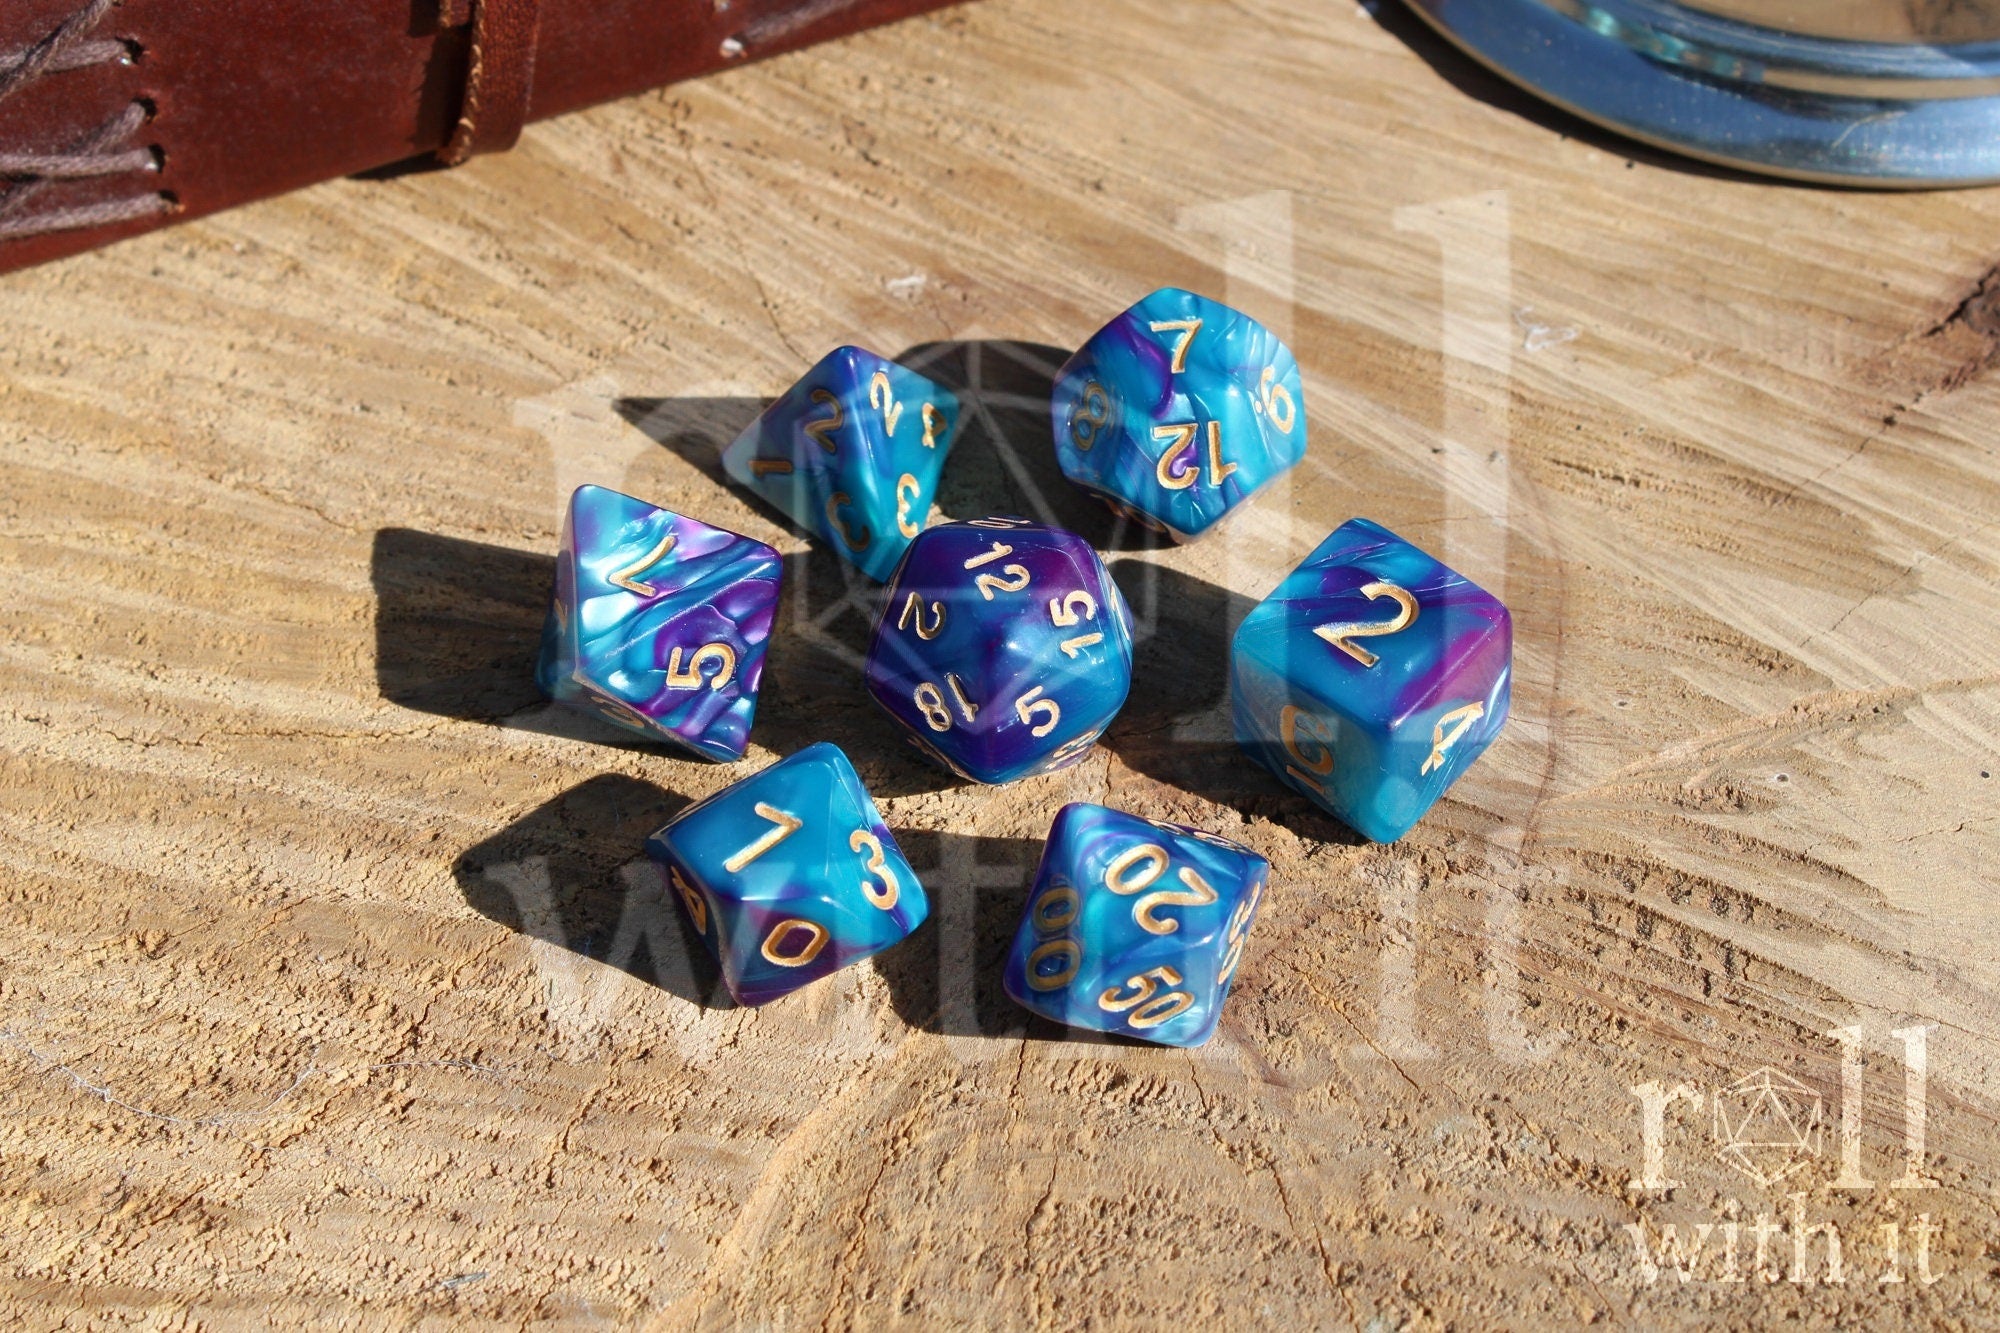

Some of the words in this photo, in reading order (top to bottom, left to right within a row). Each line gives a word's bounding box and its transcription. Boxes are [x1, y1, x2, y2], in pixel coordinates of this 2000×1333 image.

[1151, 320, 1202, 373] 7
[805, 388, 844, 453] 2
[870, 372, 904, 438] 2
[921, 401, 949, 449] 4
[1070, 380, 1111, 451] 8
[748, 459, 793, 479] 1
[1153, 421, 1238, 490] 12
[826, 491, 870, 552] 3
[896, 472, 920, 539] 3
[609, 535, 679, 597] 7
[963, 541, 1031, 601] 12
[898, 591, 947, 641] 2
[1050, 589, 1105, 660] 15
[1311, 582, 1418, 668] 2
[665, 642, 736, 690] 5
[912, 671, 980, 732] 18
[1015, 685, 1061, 738] 5
[1421, 700, 1485, 777] 4
[723, 801, 803, 873] 7
[849, 828, 900, 911] 3
[669, 865, 707, 936] 4
[1104, 843, 1219, 936] 20
[761, 918, 831, 968] 0
[1026, 887, 1082, 993] 00
[1097, 966, 1195, 1029] 50
